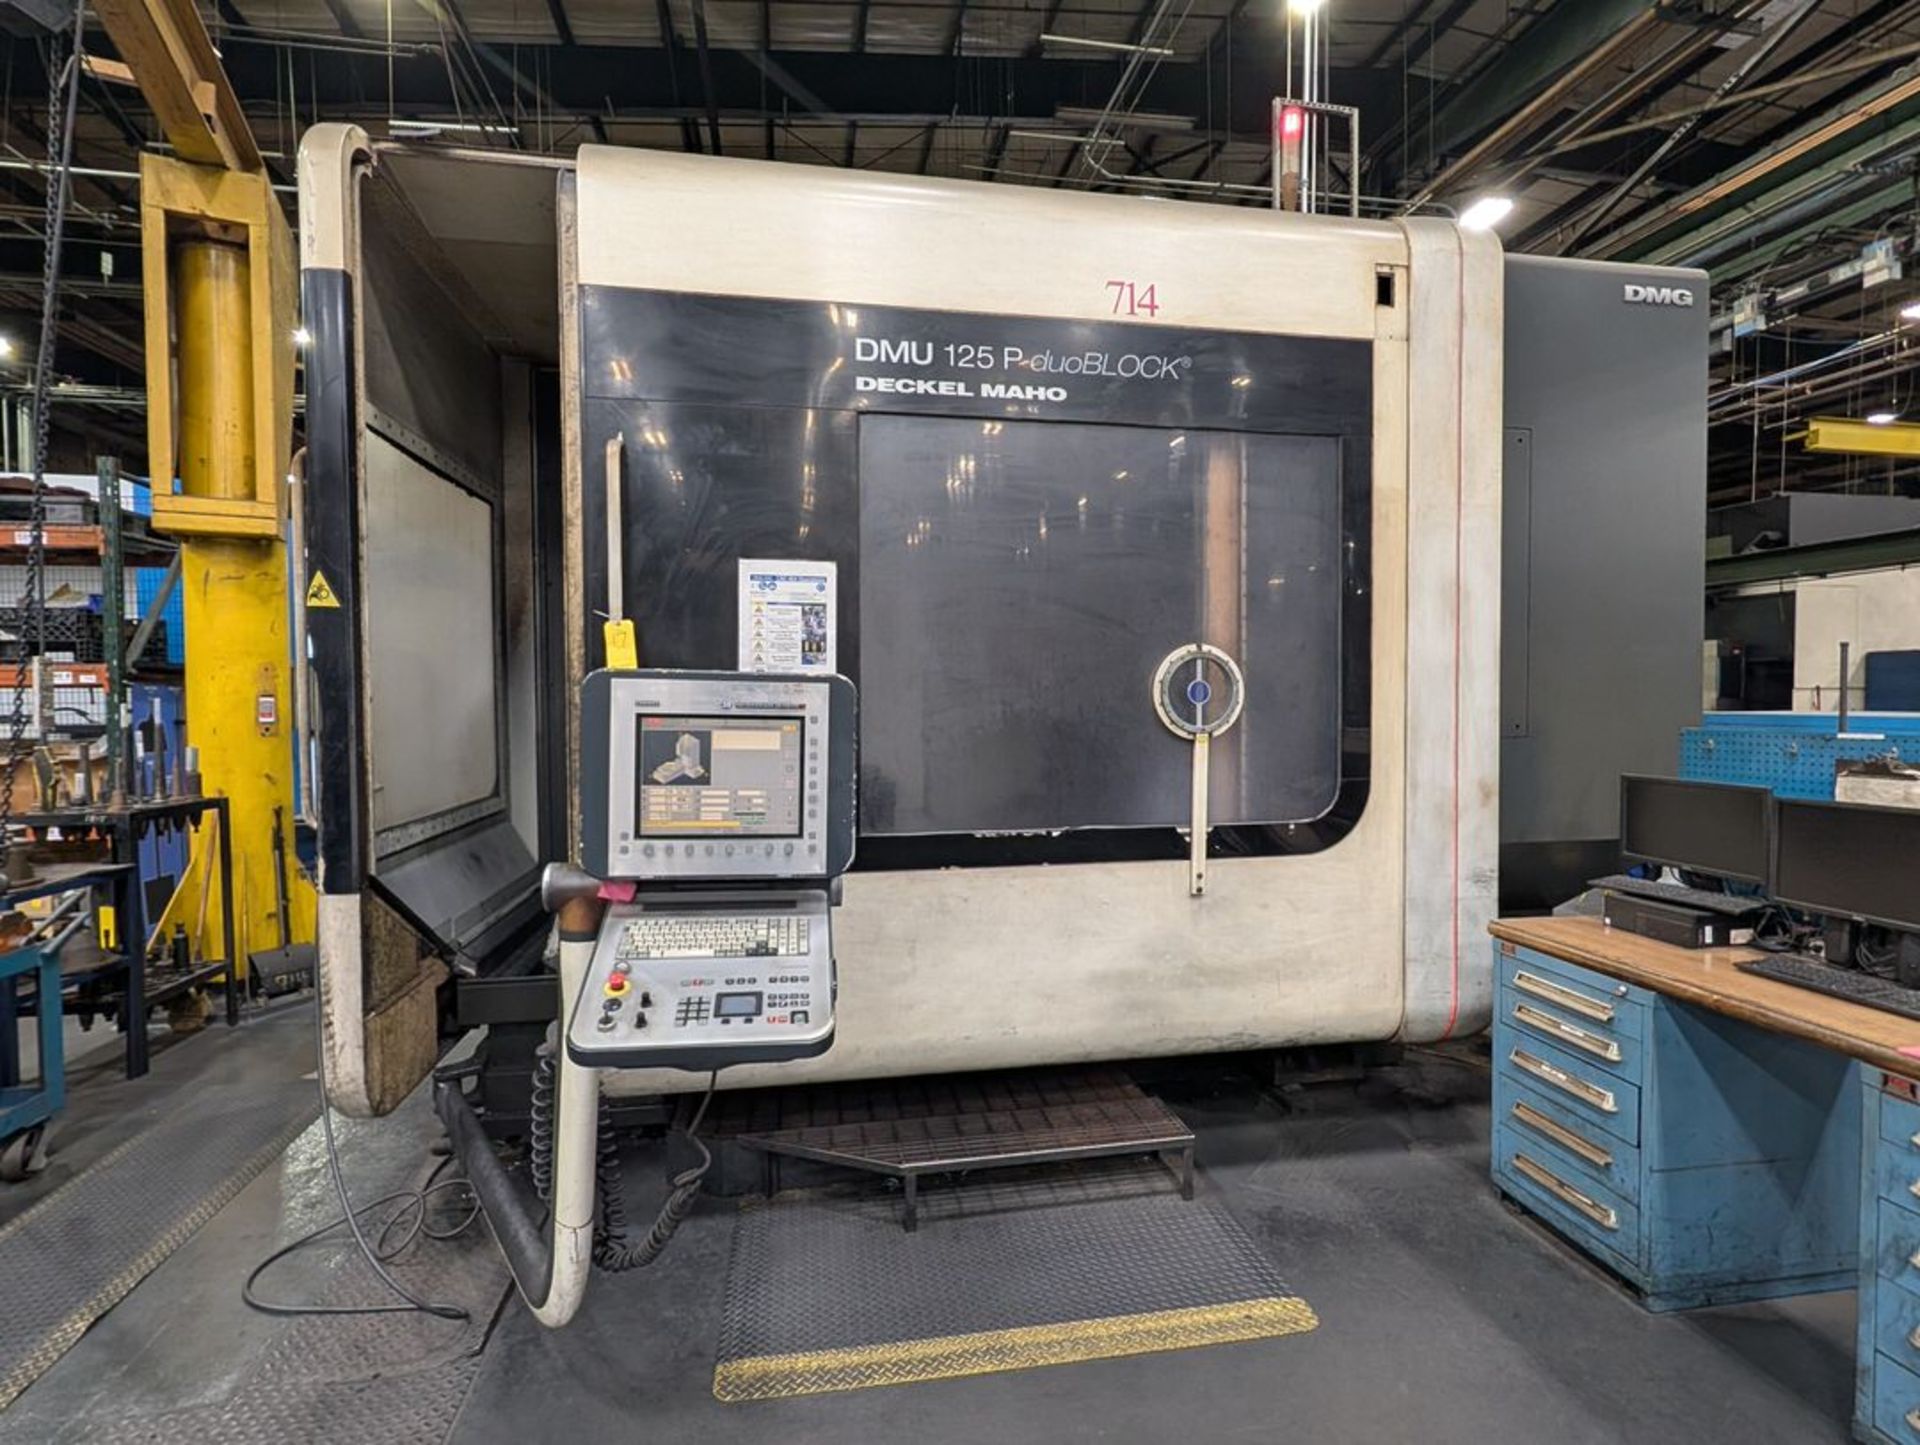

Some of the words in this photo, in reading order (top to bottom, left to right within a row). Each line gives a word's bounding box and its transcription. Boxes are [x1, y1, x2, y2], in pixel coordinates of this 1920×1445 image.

[1105, 281, 1159, 317] 714
[1624, 284, 1694, 306] DMG
[855, 338, 933, 366] DMU
[944, 343, 995, 370] 125
[855, 376, 974, 397] DECKEL
[980, 383, 1068, 402] MAHO
